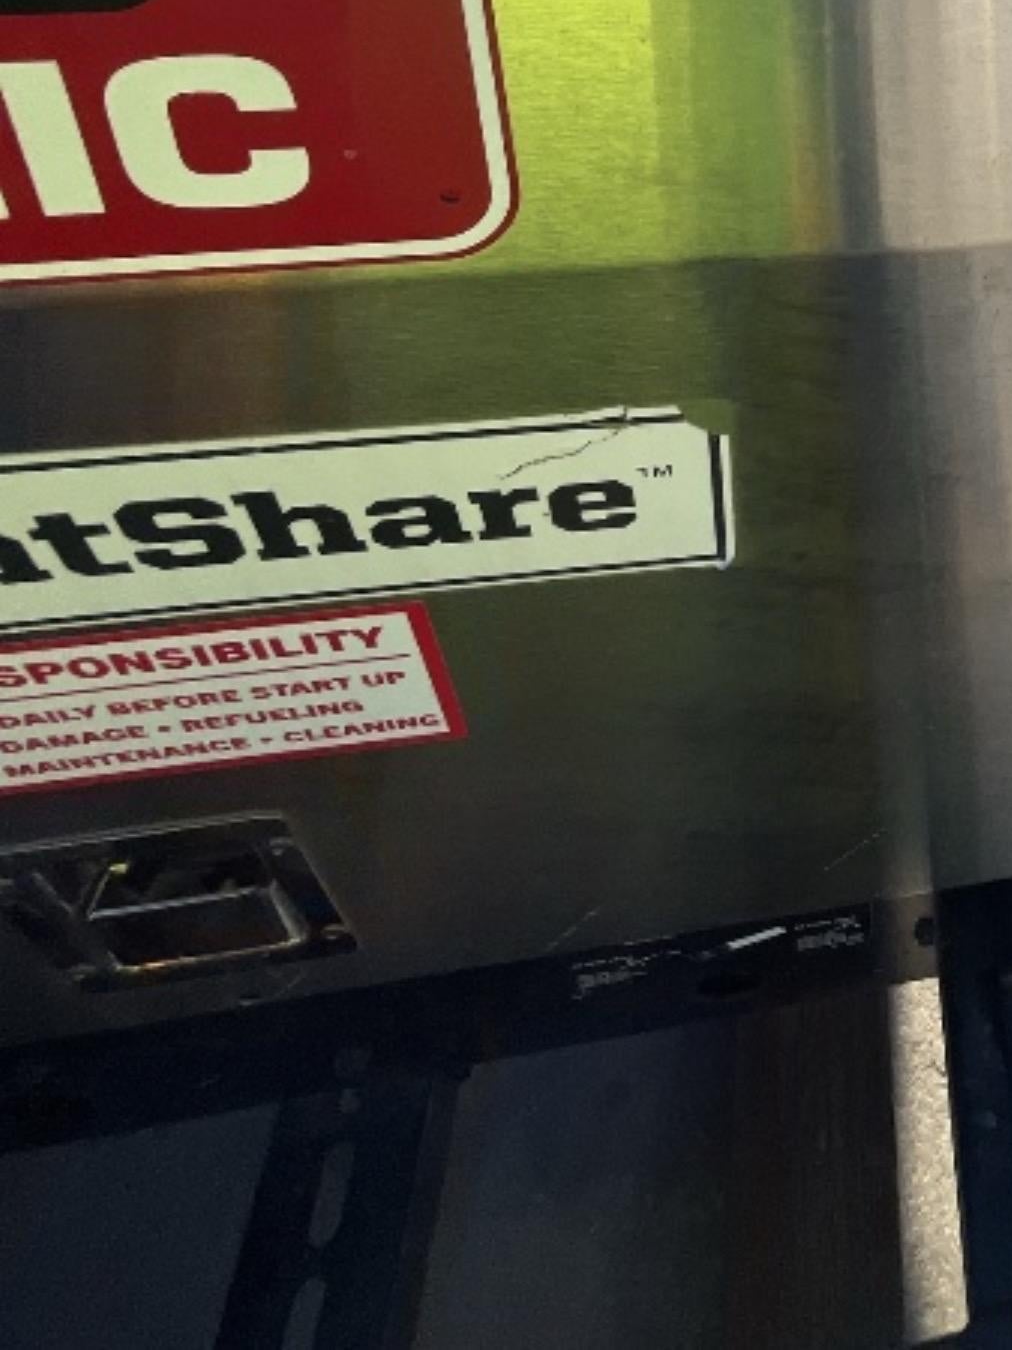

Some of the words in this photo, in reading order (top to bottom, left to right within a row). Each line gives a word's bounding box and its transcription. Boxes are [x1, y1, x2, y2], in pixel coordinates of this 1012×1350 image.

[0, 705, 95, 729] DAILY
[106, 689, 242, 715] BEFORE
[250, 677, 350, 699] START
[361, 671, 405, 687] UP
[0, 726, 148, 753] DAMAGE
[180, 700, 364, 732] REFUELING
[4, 737, 250, 777] MAINTENANCE
[284, 714, 439, 742] CLEANING
